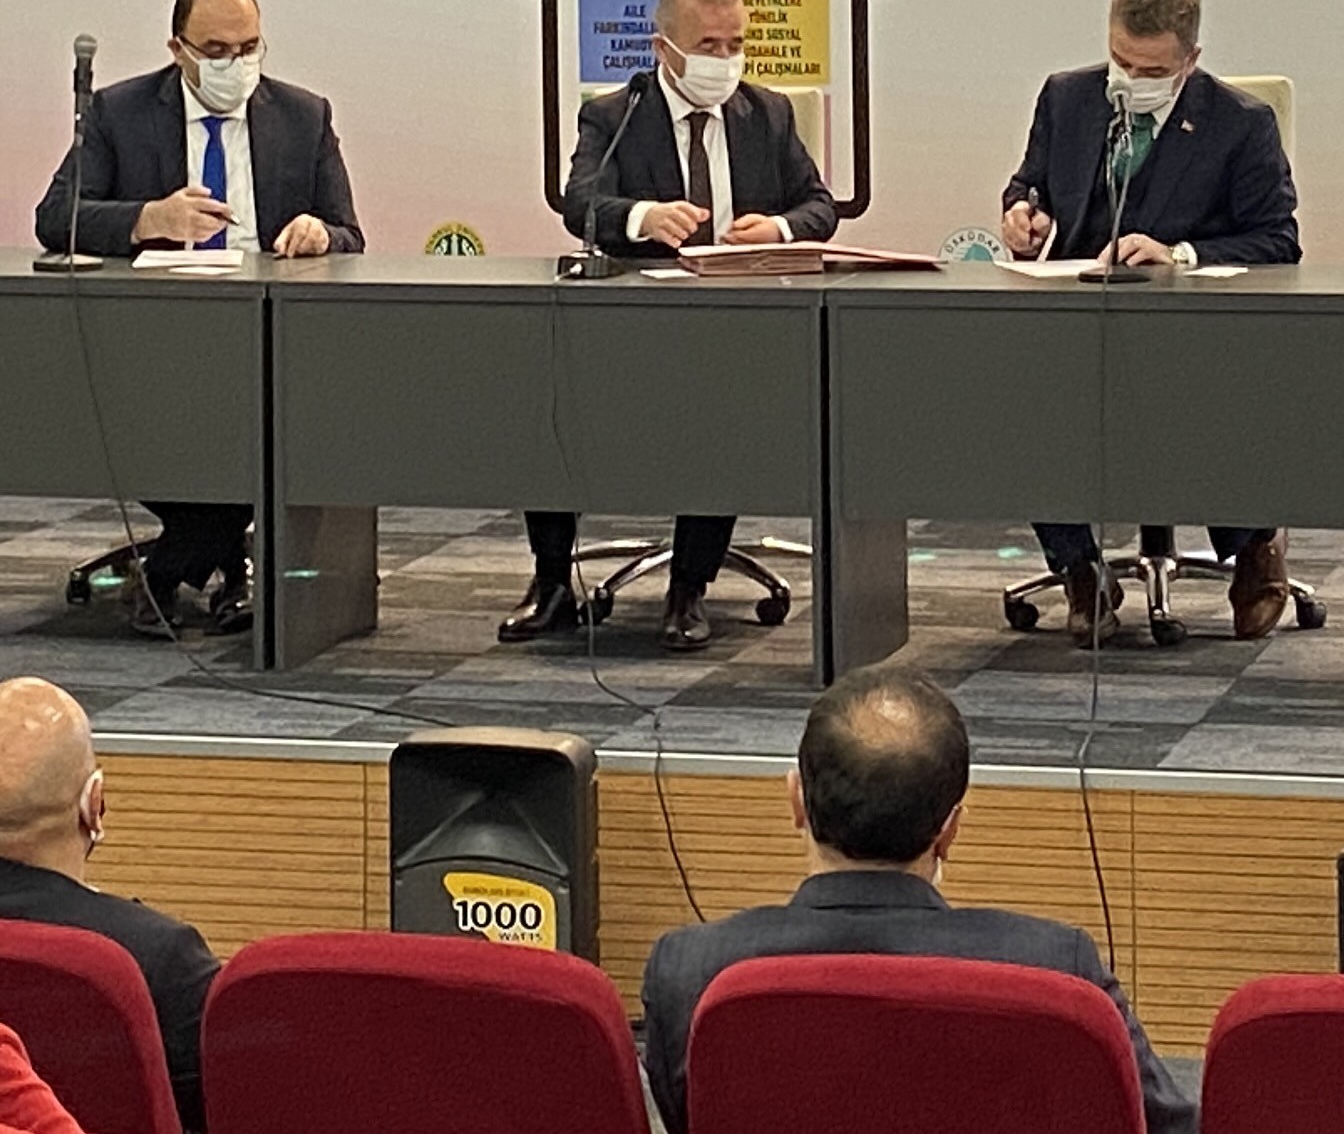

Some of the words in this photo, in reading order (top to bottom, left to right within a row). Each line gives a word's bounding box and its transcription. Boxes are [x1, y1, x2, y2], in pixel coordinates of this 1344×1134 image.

[790, 45, 801, 58] VE
[456, 900, 543, 930] 1000
[499, 931, 544, 943] WATTS
